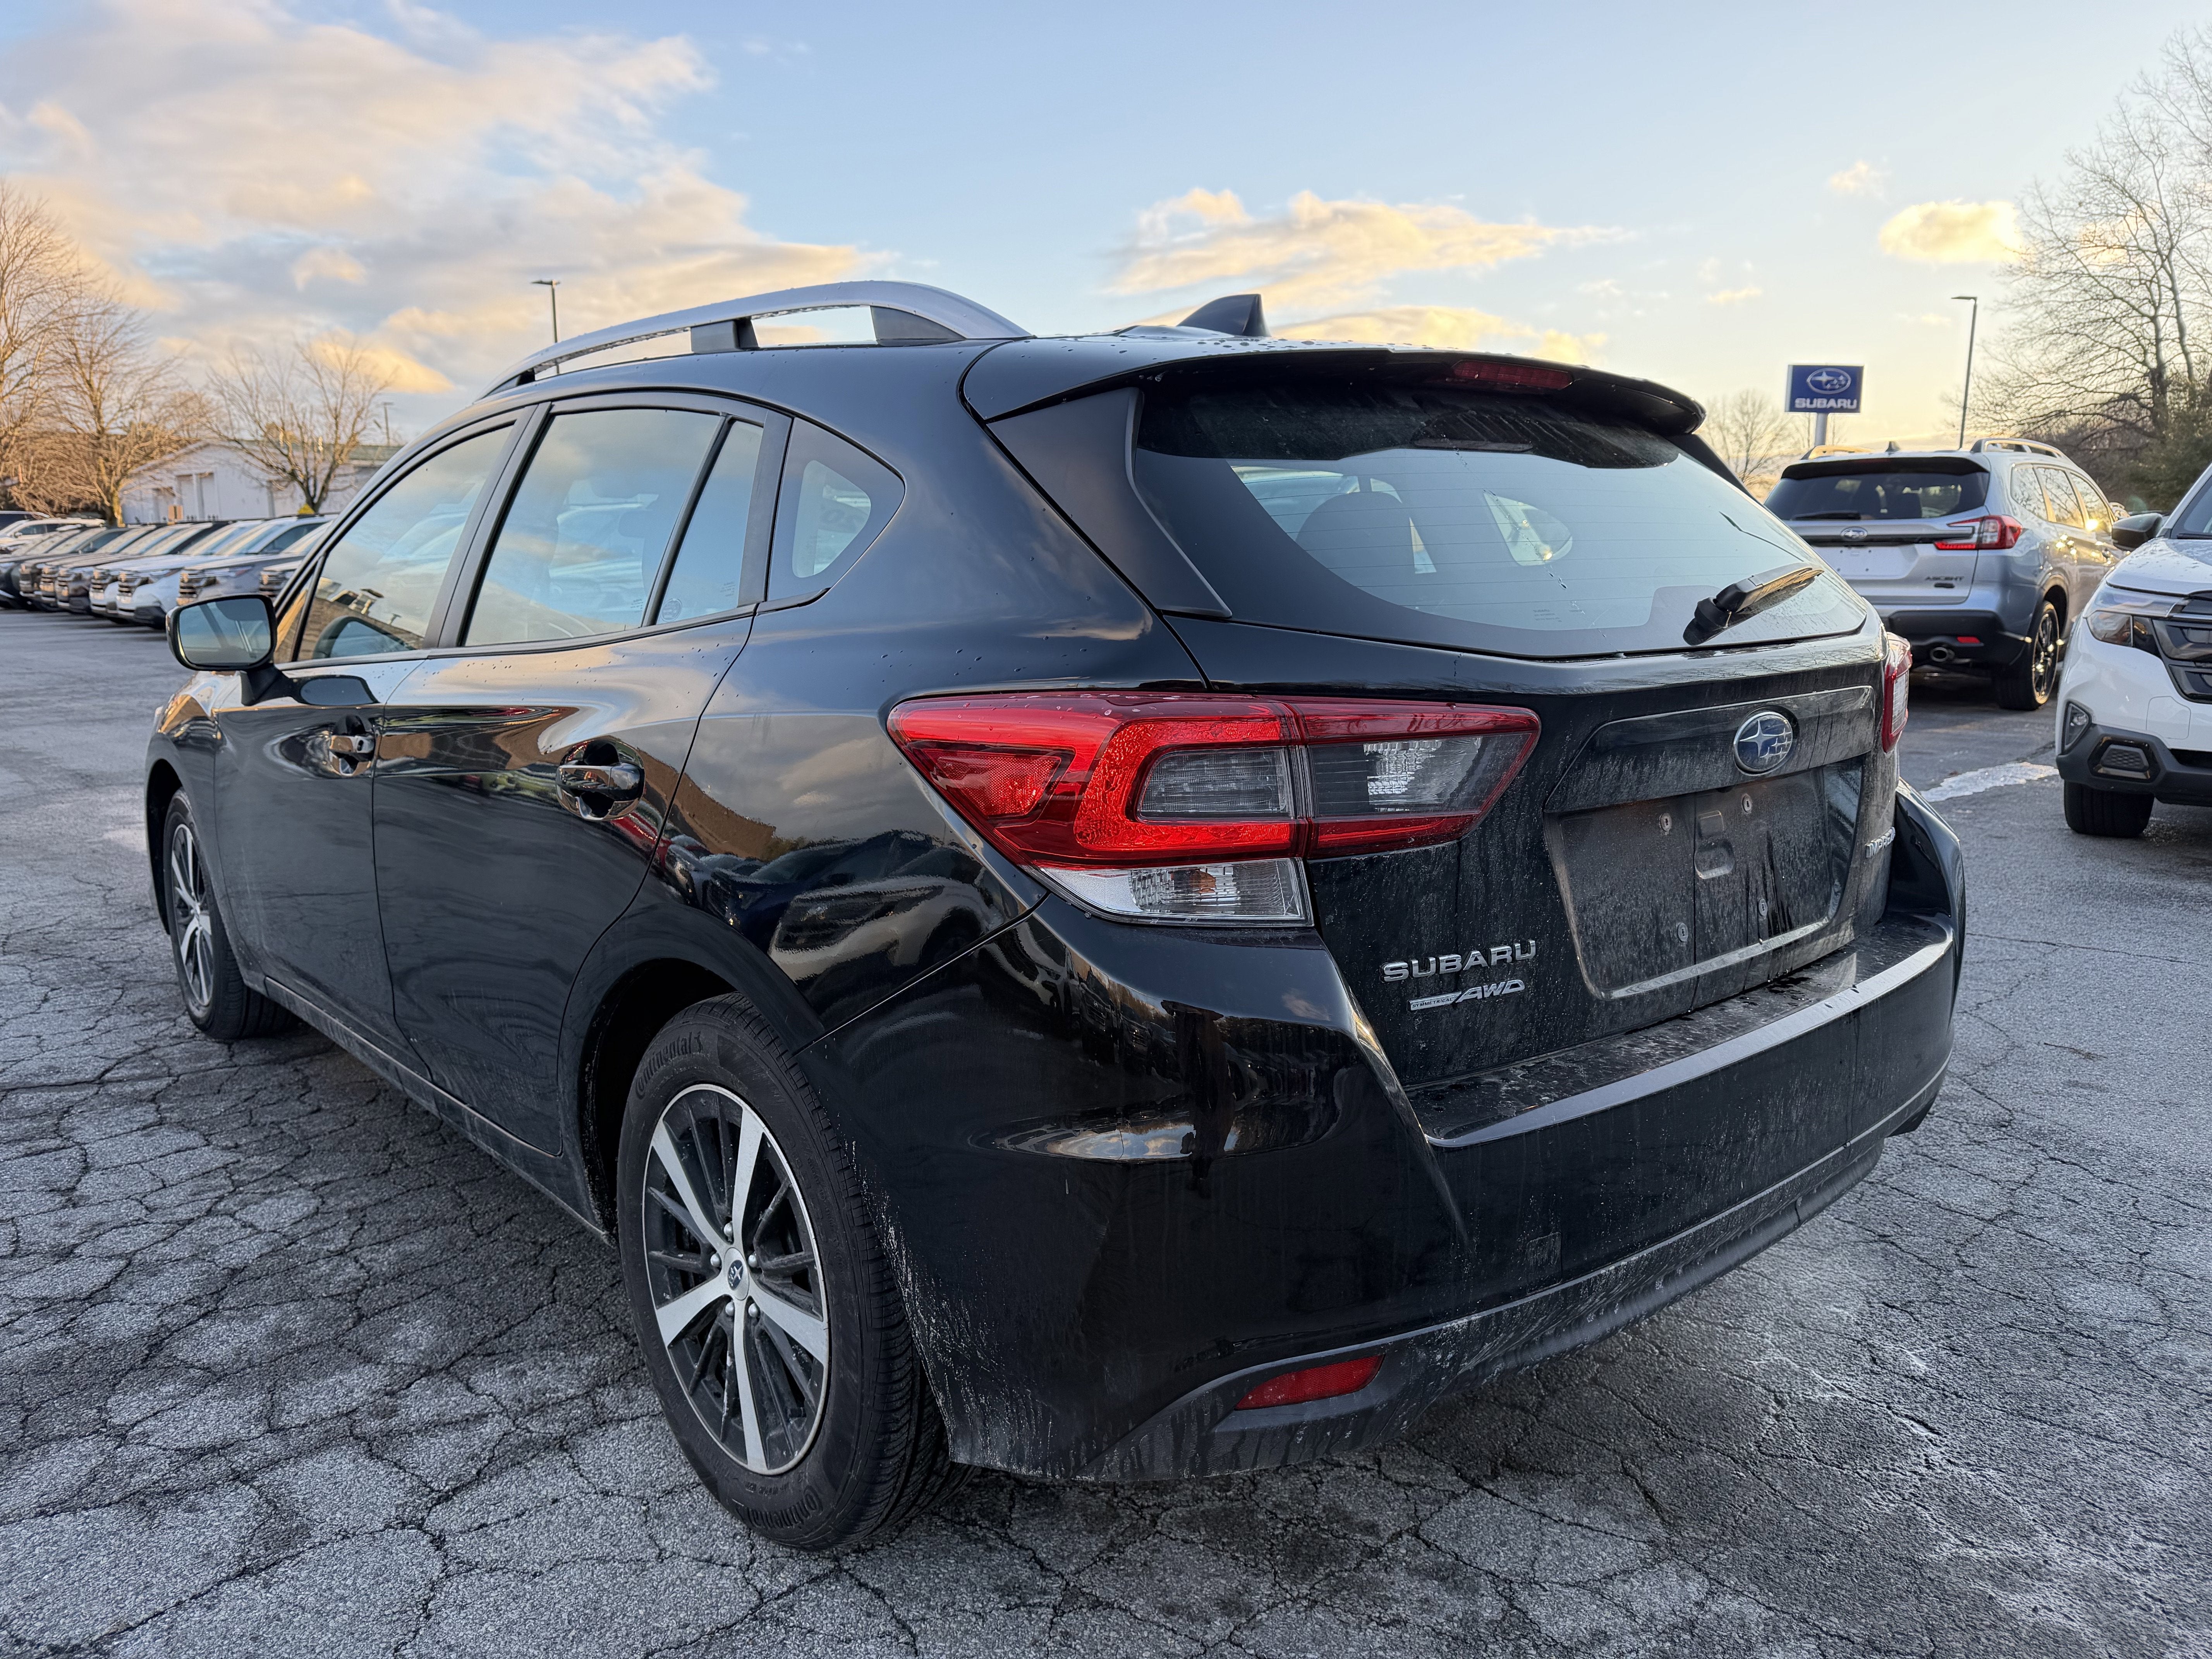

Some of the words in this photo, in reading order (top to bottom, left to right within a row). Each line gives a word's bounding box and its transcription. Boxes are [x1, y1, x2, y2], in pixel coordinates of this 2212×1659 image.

[1795, 398, 1857, 409] SUBARU
[1382, 939, 1536, 982] SUBARU
[1412, 998, 1453, 1008] SYMMETRICAL
[1455, 979, 1525, 1003] AWD
[635, 1031, 692, 1100] Continental
